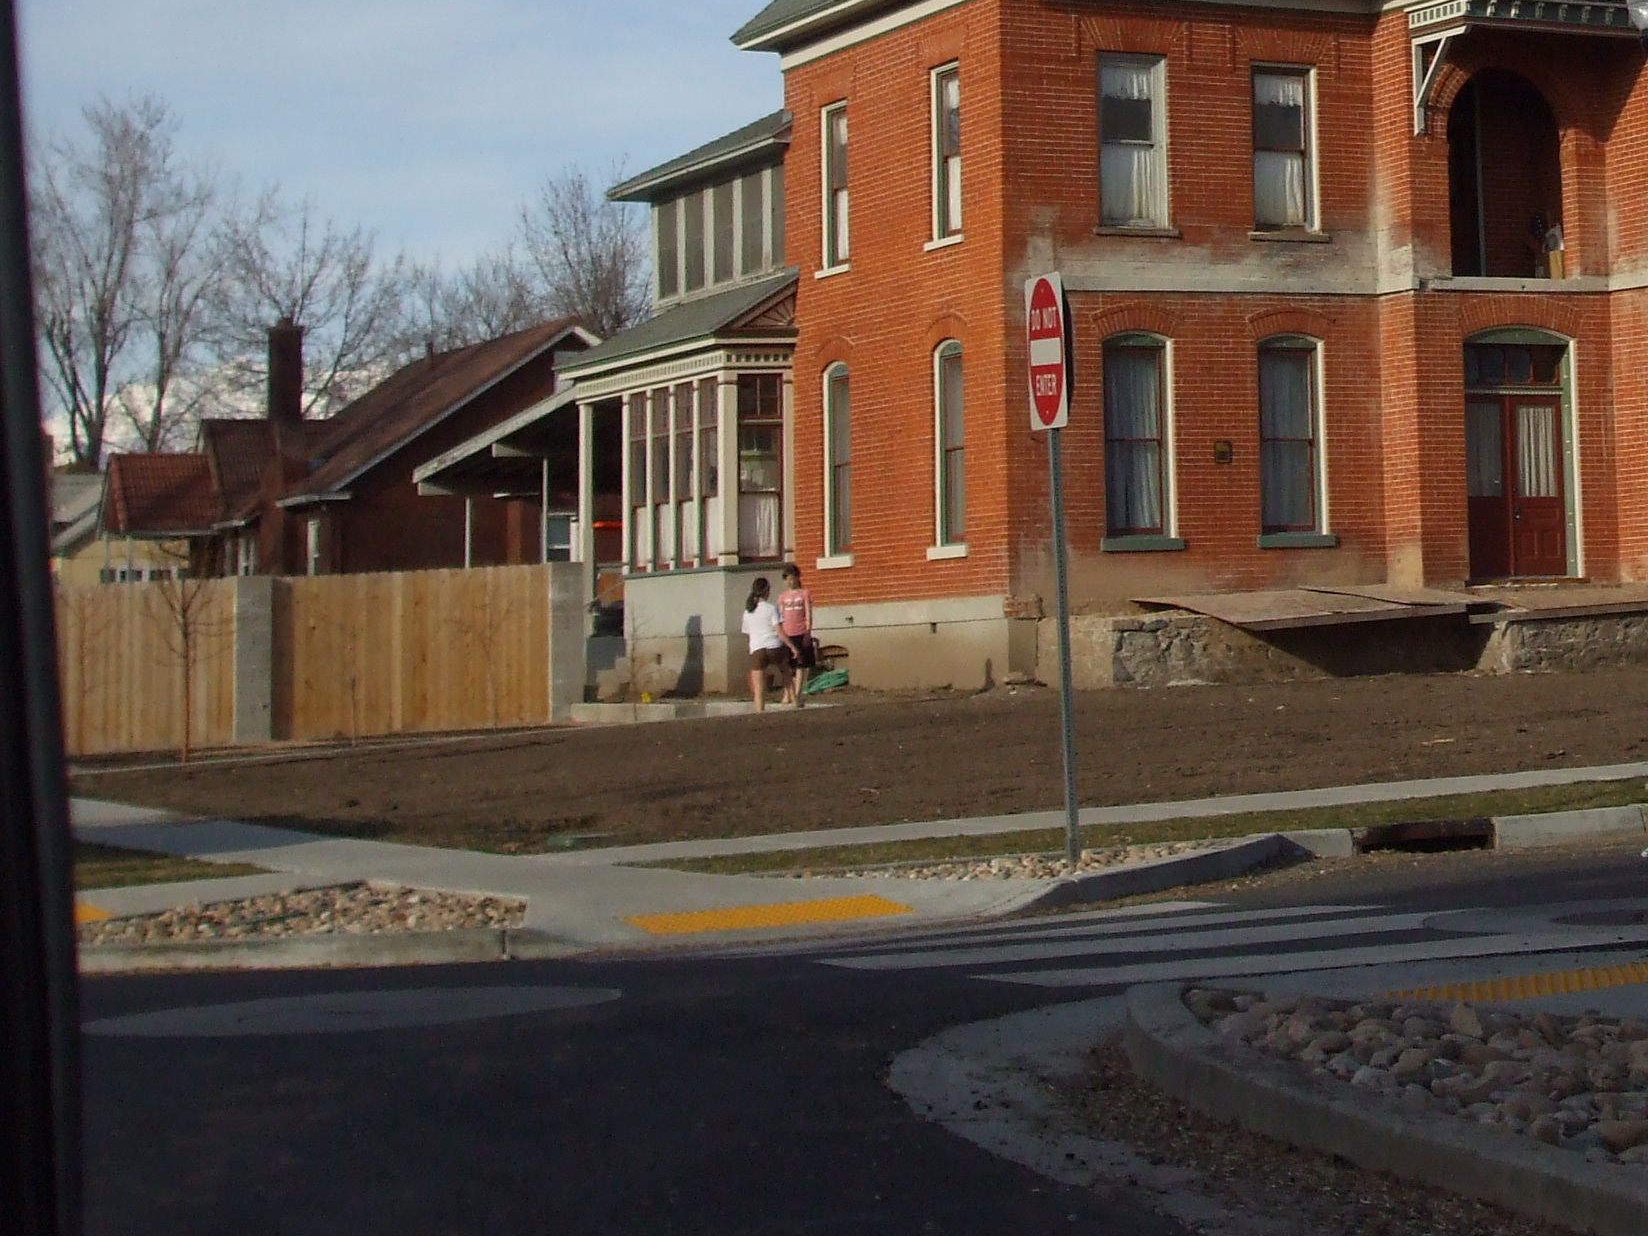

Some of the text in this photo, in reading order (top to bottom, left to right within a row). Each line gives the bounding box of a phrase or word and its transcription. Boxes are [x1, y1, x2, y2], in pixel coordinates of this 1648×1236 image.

[1031, 306, 1057, 331] DO NOT
[1035, 373, 1057, 397] ENTER
